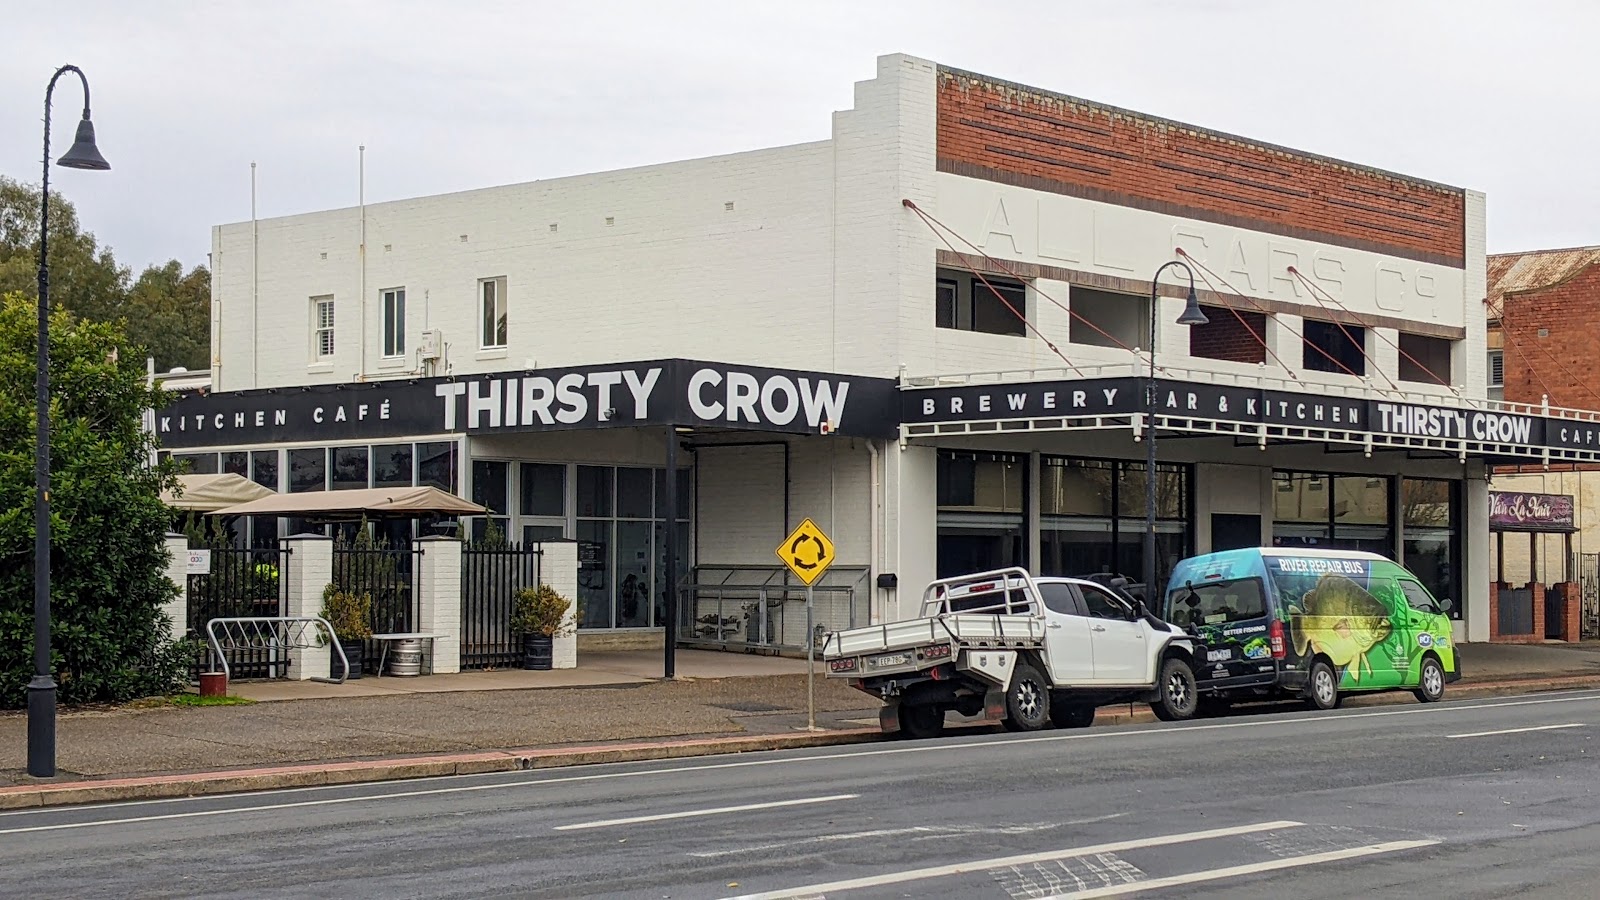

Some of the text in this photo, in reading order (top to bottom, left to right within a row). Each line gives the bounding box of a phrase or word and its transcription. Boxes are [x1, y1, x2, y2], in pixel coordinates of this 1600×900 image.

[976, 191, 1135, 272] ALL
[1170, 224, 1346, 303] CARS
[435, 367, 850, 430] THIRSTY CROW
[922, 388, 1118, 415] BREWERY
[1218, 396, 1228, 413] &
[1246, 398, 1359, 424] KITCHEN
[161, 398, 391, 433] KITCHEN CAFÉ
[1377, 403, 1532, 444] THIRSTY CROW
[1560, 427, 1600, 445] CAF
[1278, 558, 1365, 574] RIVER REPAIR BUS
[1222, 625, 1267, 637] BETTER FISHING
